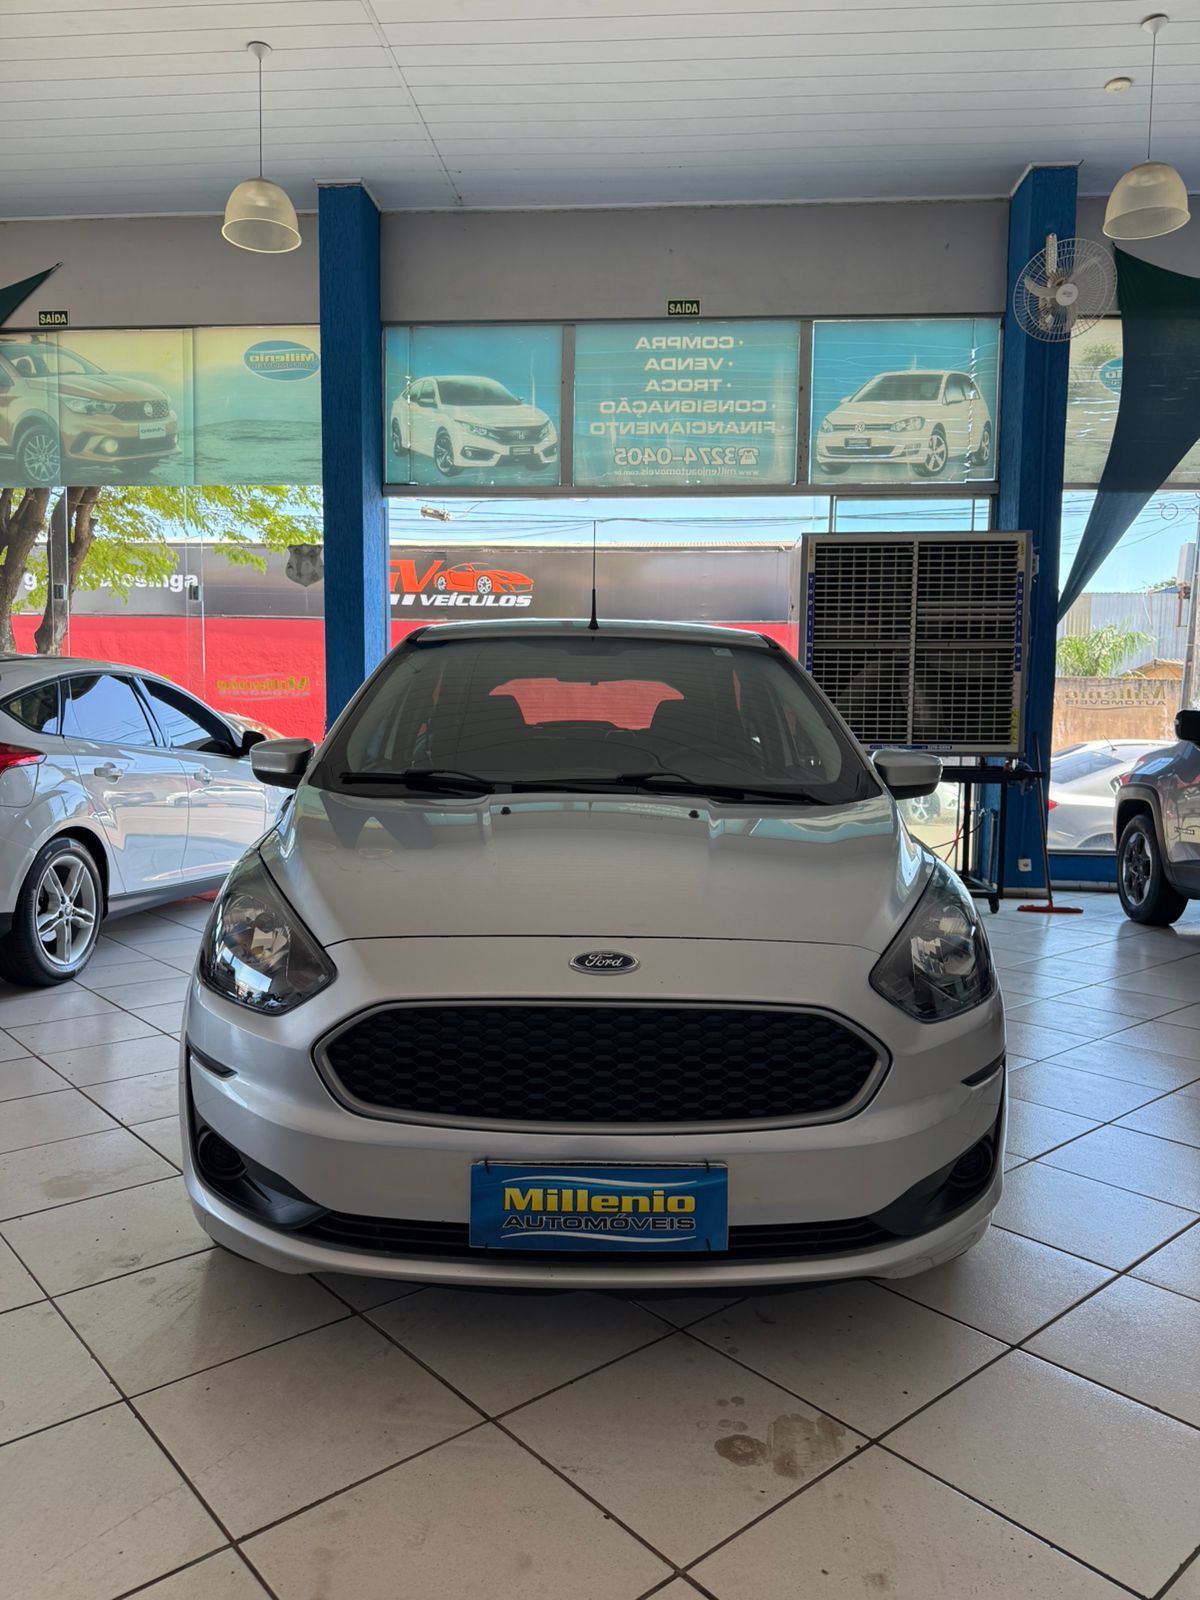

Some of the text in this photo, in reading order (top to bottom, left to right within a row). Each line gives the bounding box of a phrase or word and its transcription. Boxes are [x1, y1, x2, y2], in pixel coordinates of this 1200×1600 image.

[669, 301, 699, 314] SAÍDA
[40, 312, 67, 324] SAÍDA
[420, 592, 532, 607] VEÍCULOS
[585, 953, 623, 967] Ford
[503, 1187, 696, 1213] Millenio
[502, 1214, 696, 1231] AUTOMÓVEIS
